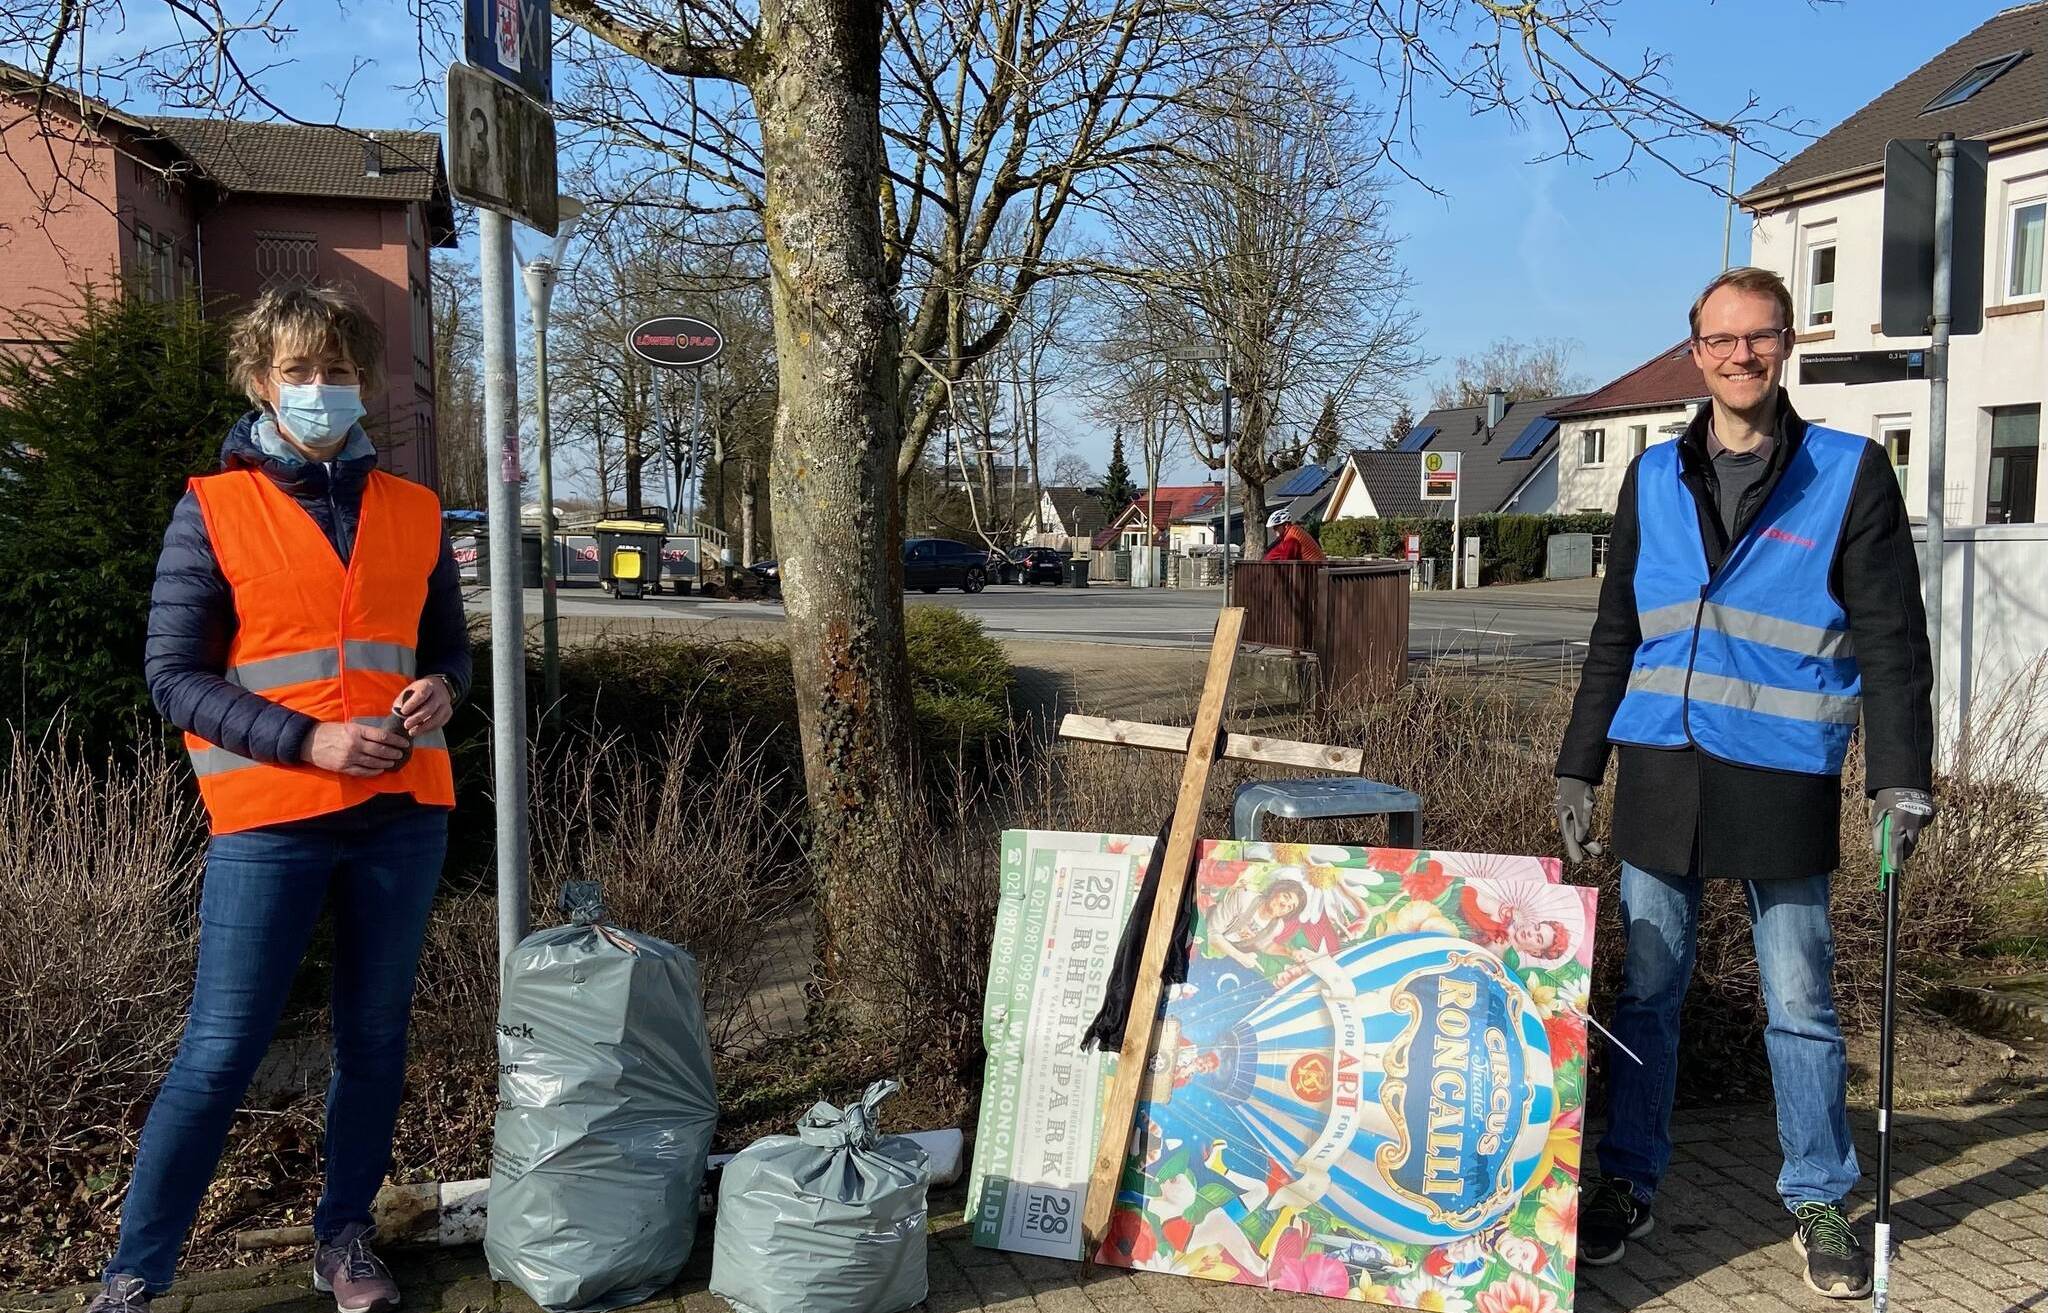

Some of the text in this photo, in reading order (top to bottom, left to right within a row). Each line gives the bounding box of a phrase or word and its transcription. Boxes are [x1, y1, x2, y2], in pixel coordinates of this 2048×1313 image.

[636, 334, 717, 346] LÖWEN PLAY
[1430, 457, 1439, 468] H
[1071, 879, 1085, 906] MAI
[1084, 875, 1113, 911] 28
[998, 936, 1014, 963] 099
[1018, 953, 1035, 981] 099
[994, 965, 1010, 984] 66
[1014, 983, 1030, 1001] 66
[1042, 928, 1093, 1178] RHEINPARK
[1313, 1002, 1360, 1161] ALL FOR ART FOR ALL
[1423, 976, 1477, 1196] RONCALLI
[1471, 1055, 1489, 1122] Theater
[1477, 1026, 1511, 1156] CIRCUS
[980, 1020, 1024, 1236] WWW.RONCALLI.DE
[1026, 1194, 1042, 1231] JUNI
[1039, 1193, 1071, 1235] 28
